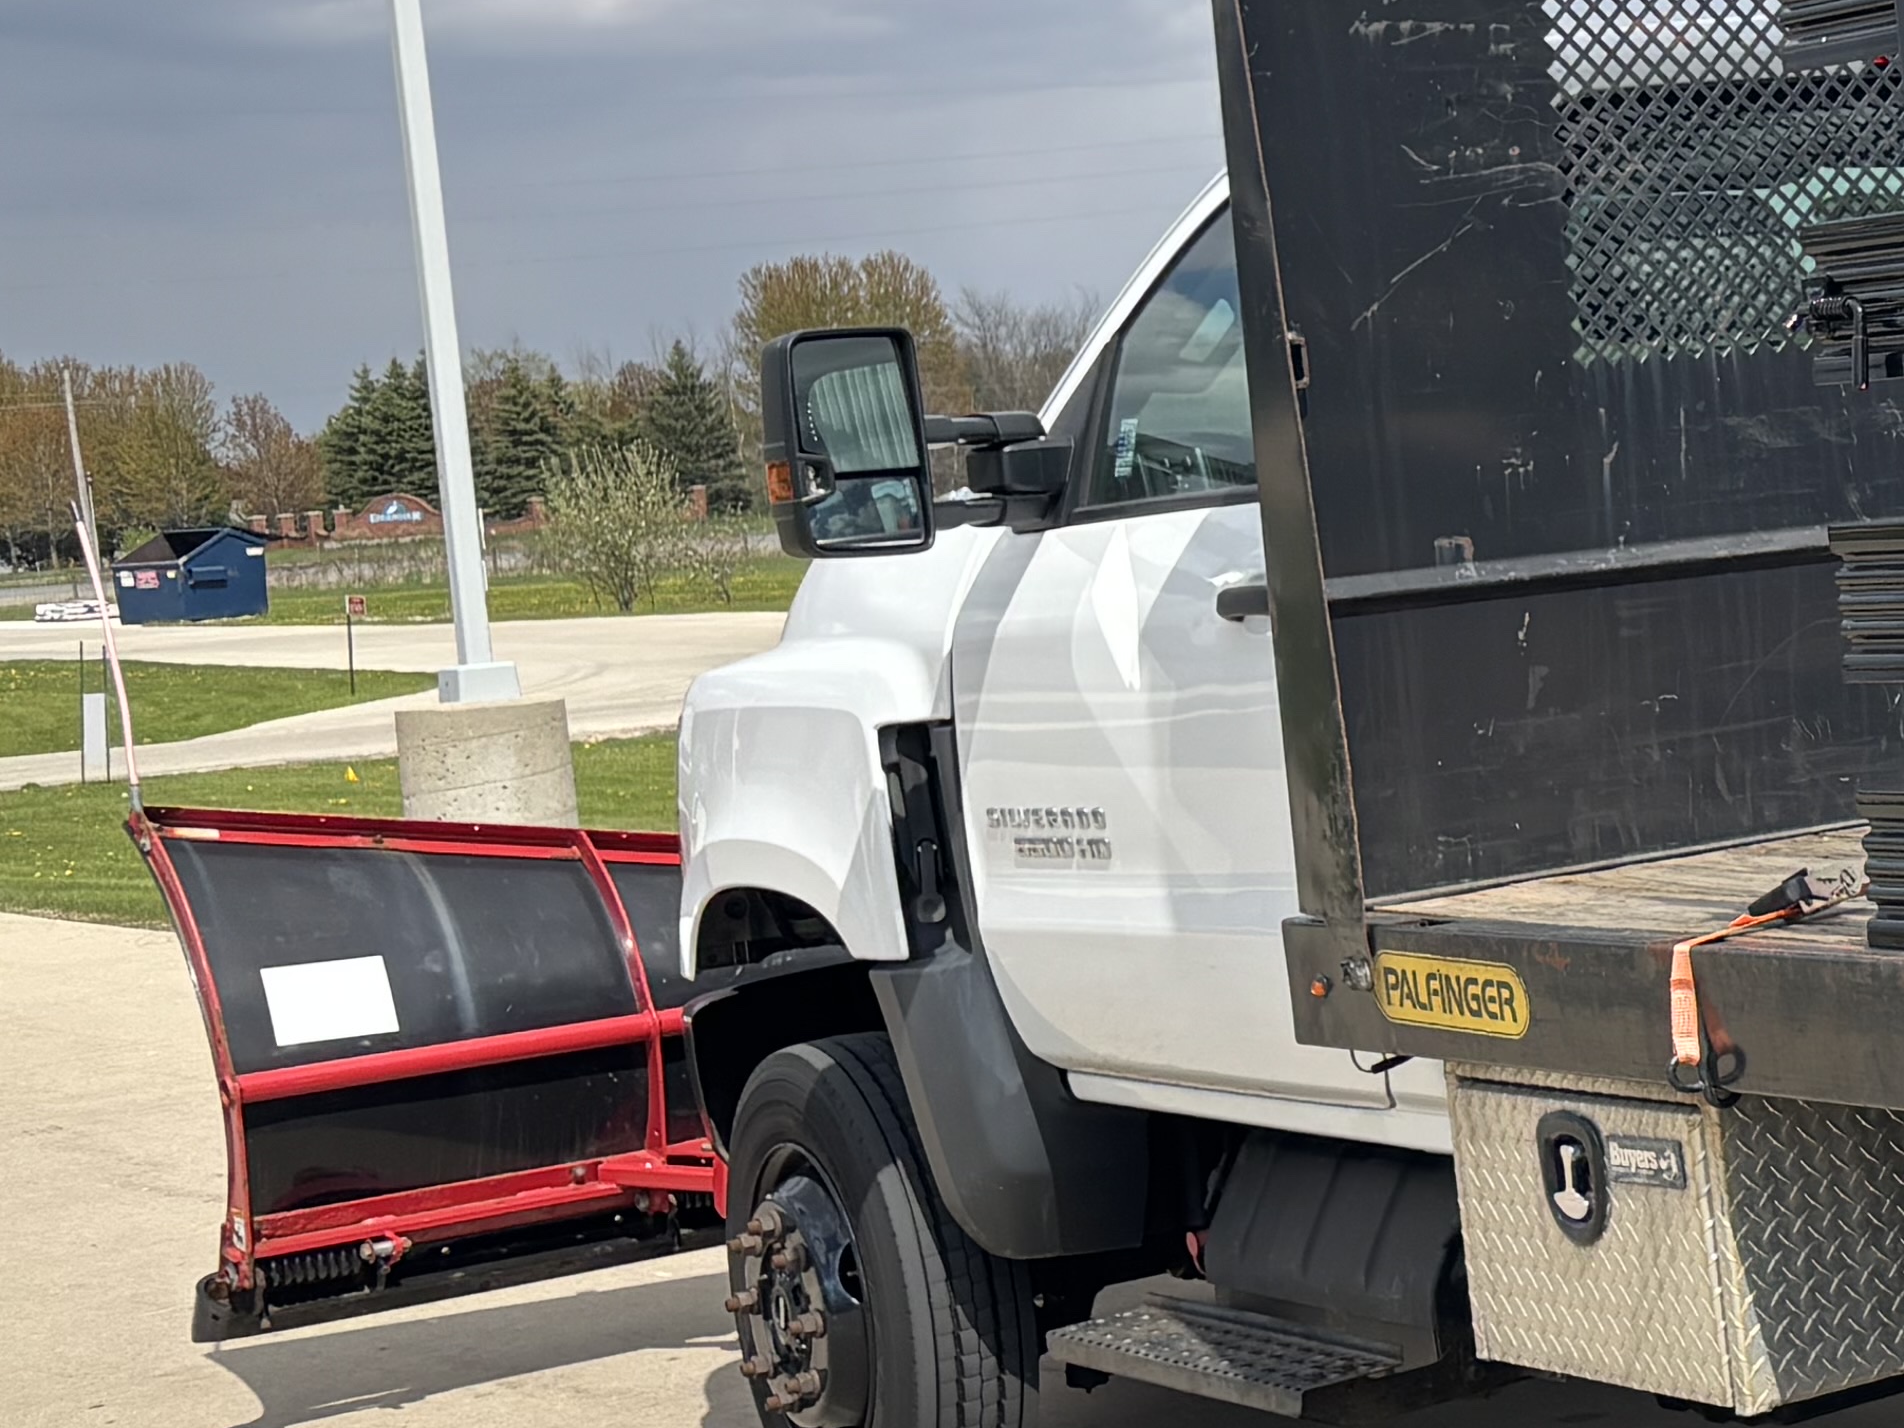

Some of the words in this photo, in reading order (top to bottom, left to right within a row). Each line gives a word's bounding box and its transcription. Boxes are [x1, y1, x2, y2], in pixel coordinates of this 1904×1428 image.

[986, 807, 1107, 830] SILVERADO
[1383, 967, 1517, 1023] PALFINGER
[1608, 1141, 1658, 1173] Buyers
